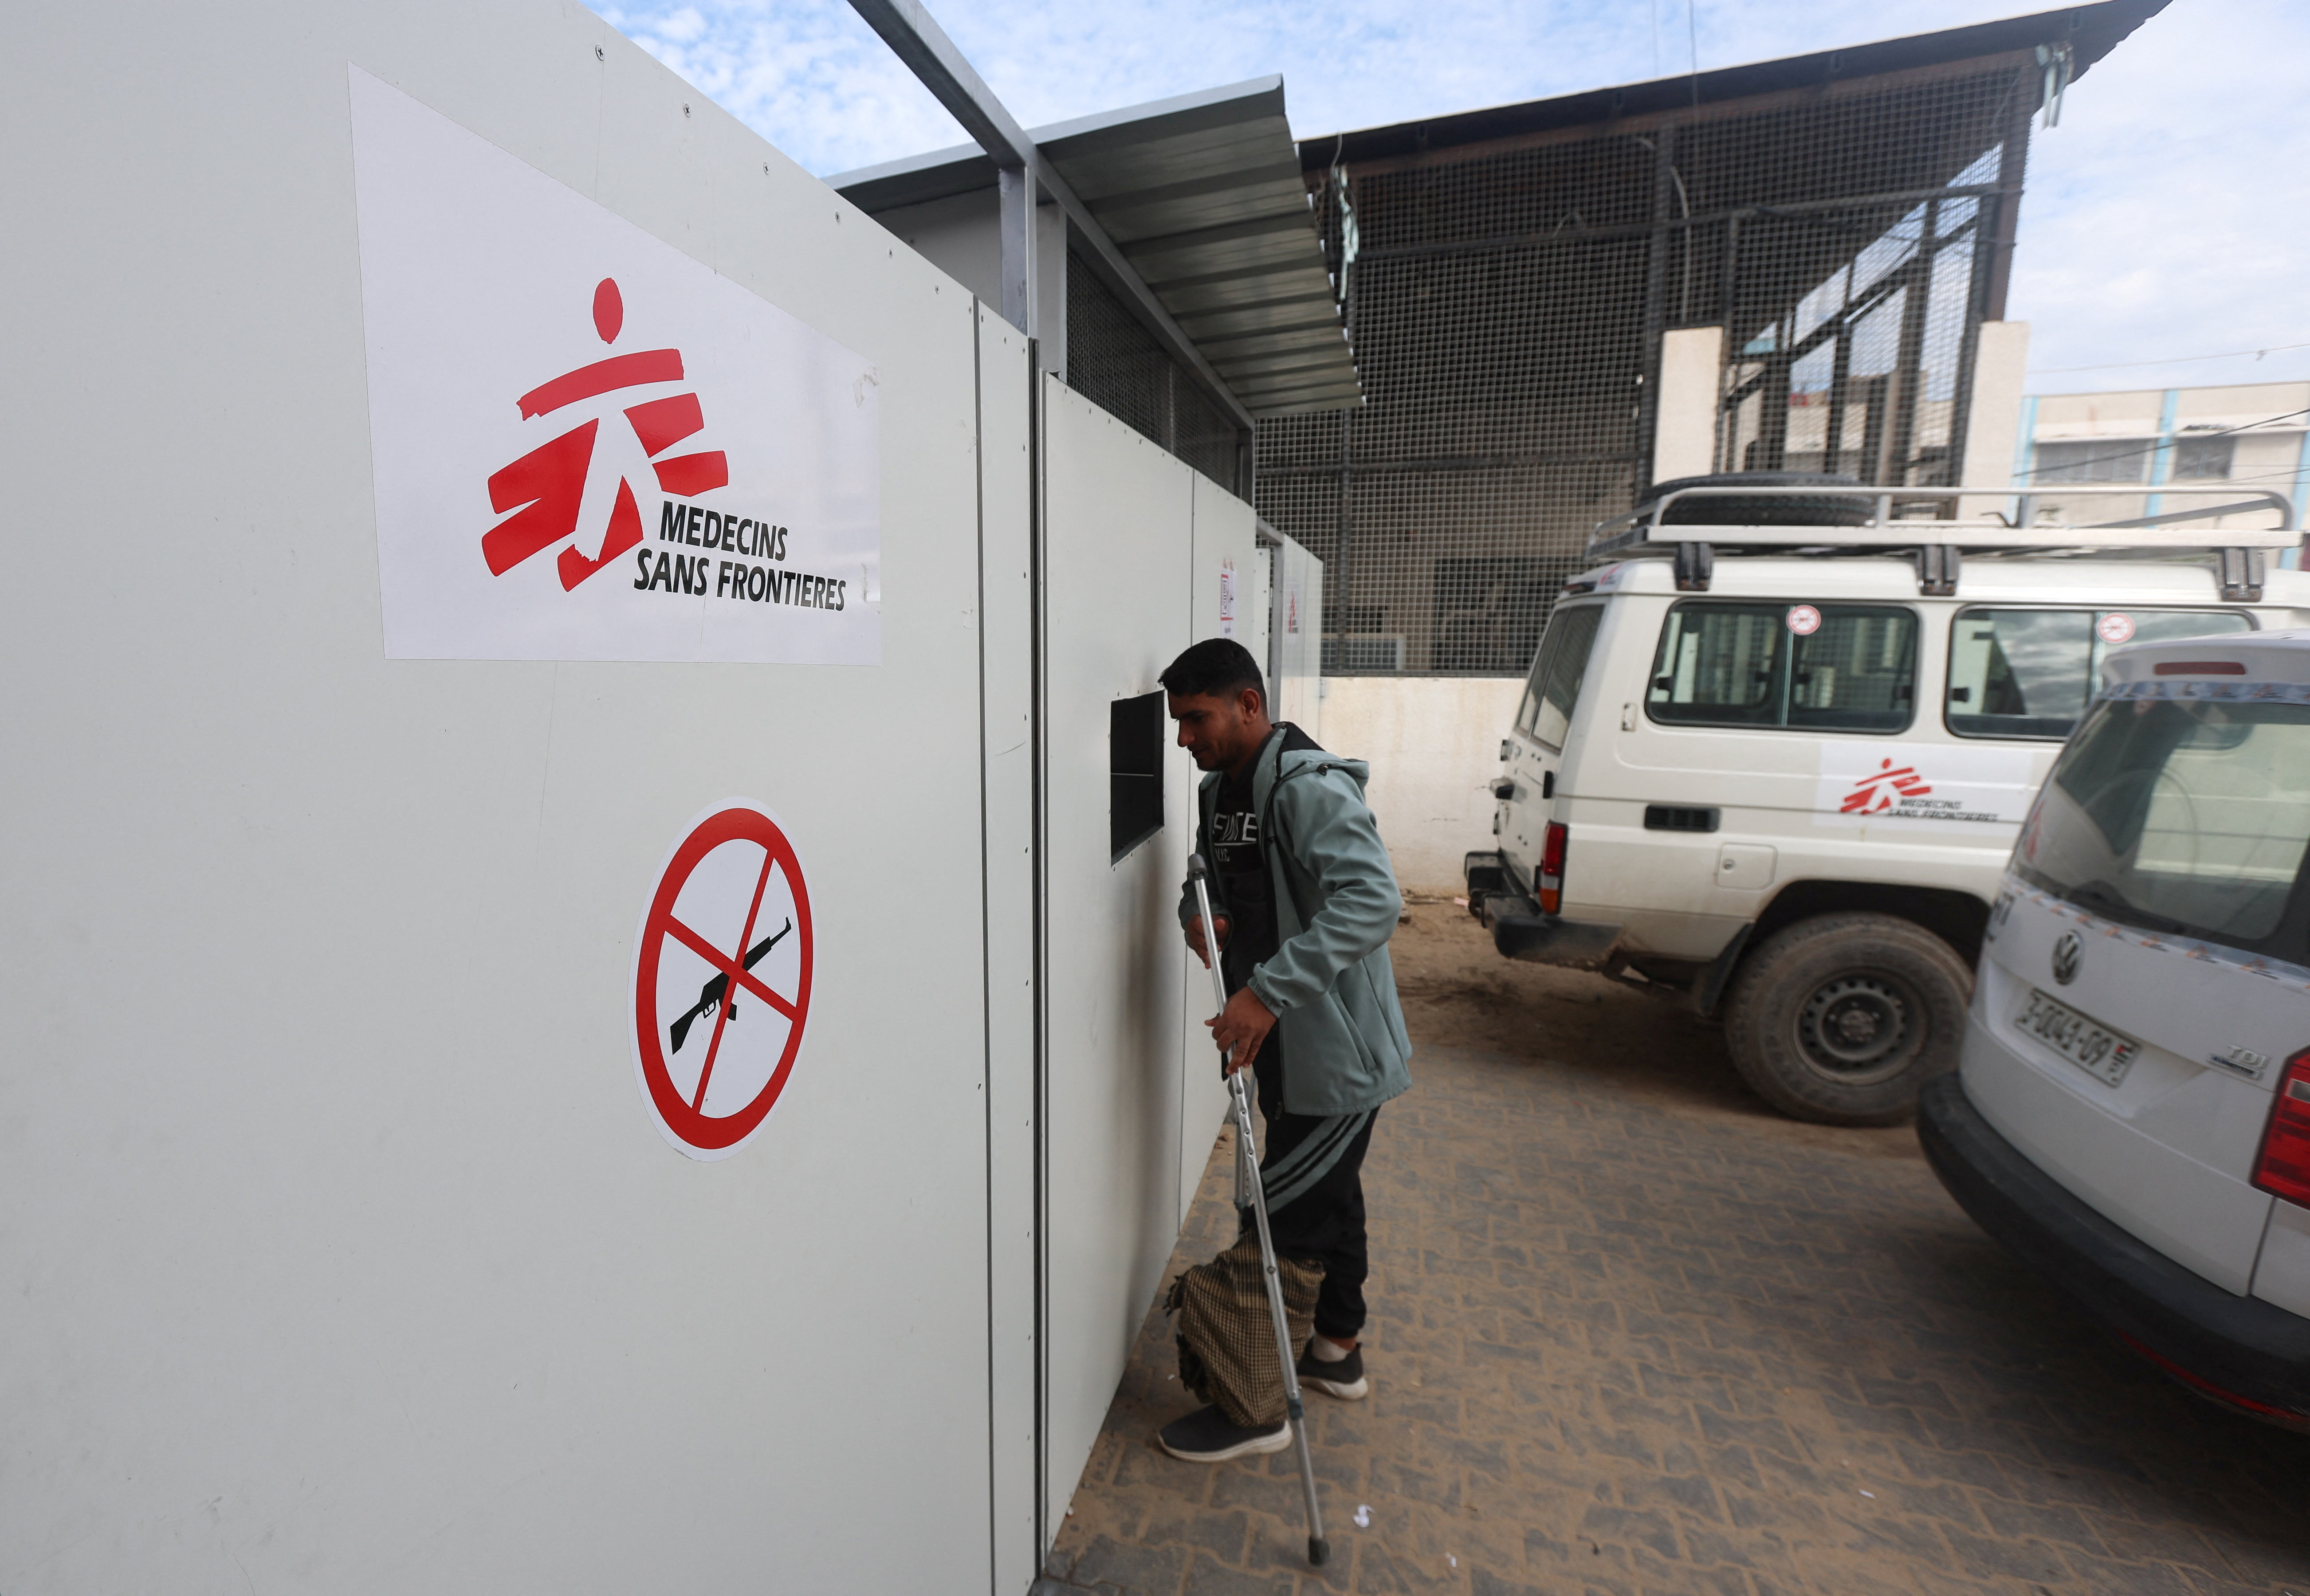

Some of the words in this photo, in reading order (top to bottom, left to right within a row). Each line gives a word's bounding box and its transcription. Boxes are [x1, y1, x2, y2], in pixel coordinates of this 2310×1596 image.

[660, 501, 788, 561] MEDECINS
[633, 548, 710, 596] SANS
[716, 561, 846, 611] FRONTIERES
[2227, 1043, 2268, 1069] TDI
